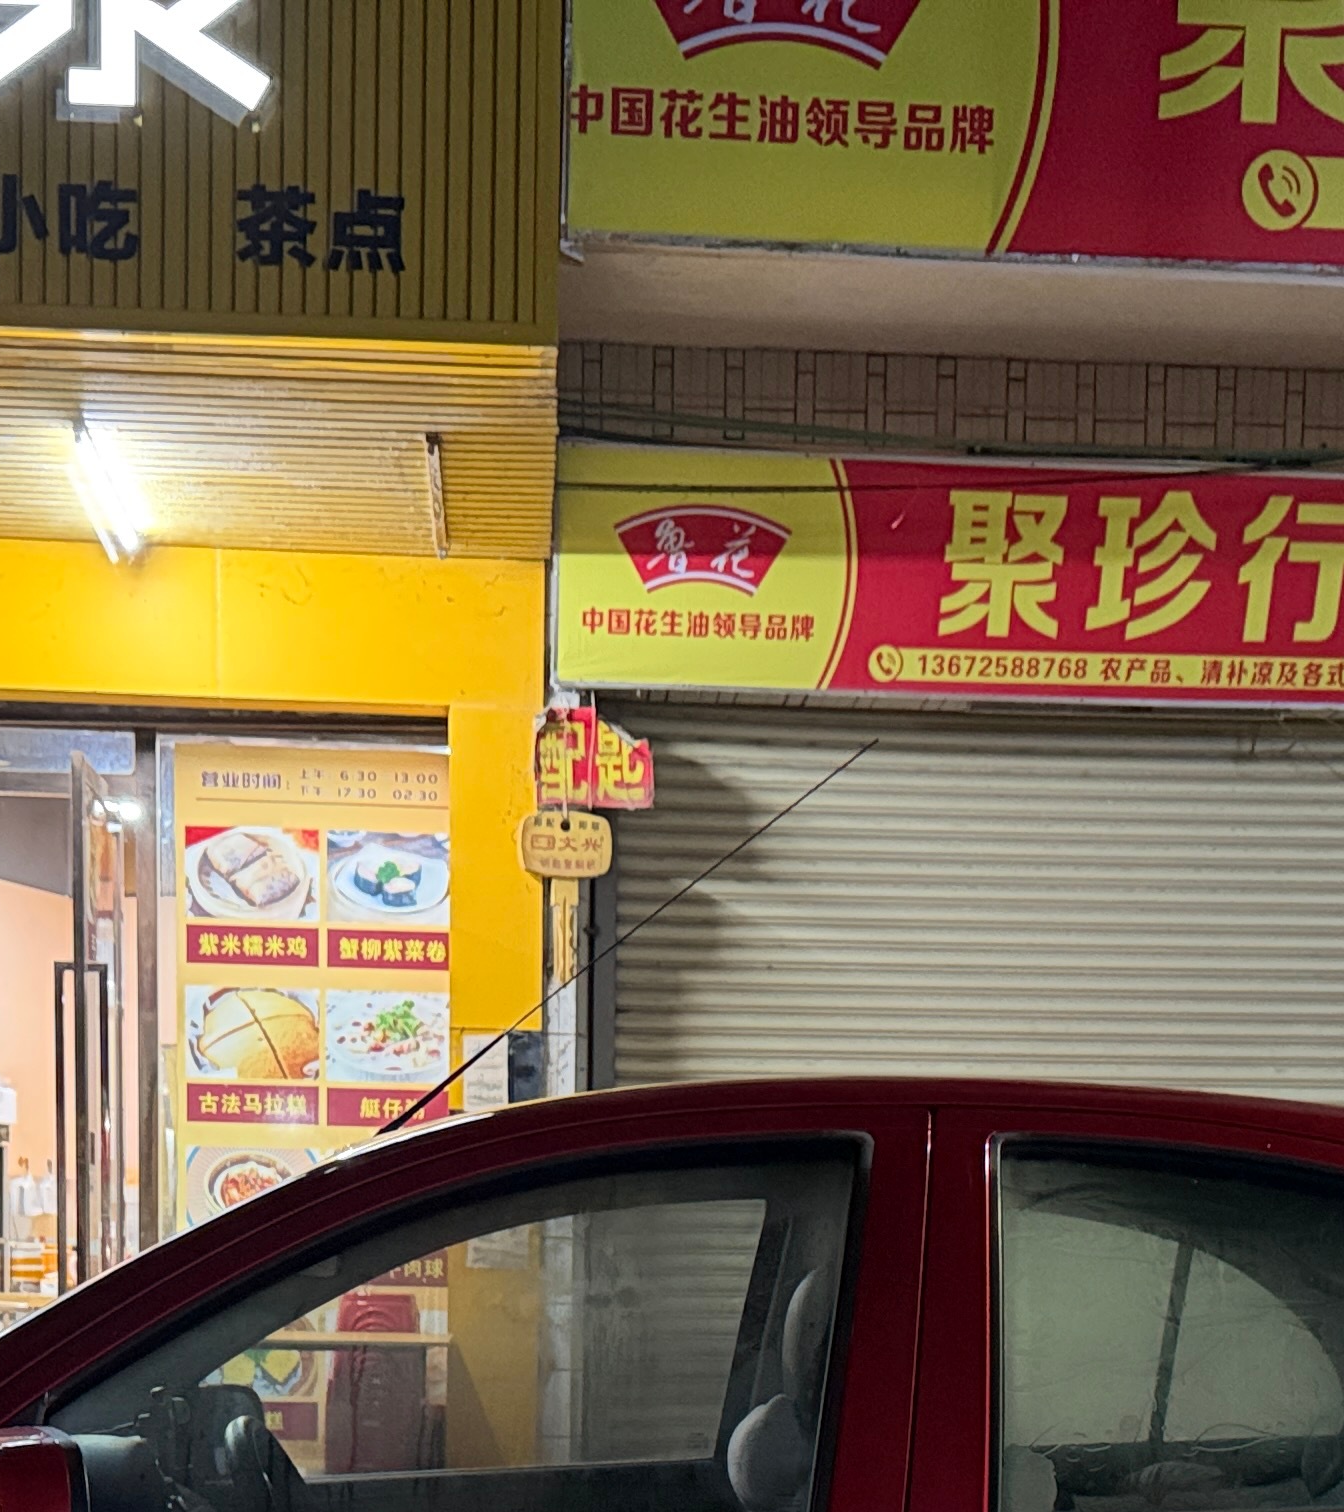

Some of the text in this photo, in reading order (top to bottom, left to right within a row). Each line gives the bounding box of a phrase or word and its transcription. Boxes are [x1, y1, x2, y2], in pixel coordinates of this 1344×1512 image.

[569, 84, 996, 154] 中国花生油领导品牌
[236, 184, 406, 274] 茶点
[581, 608, 816, 642] 中国花生油领导品牌
[918, 654, 1088, 680] 13672588768
